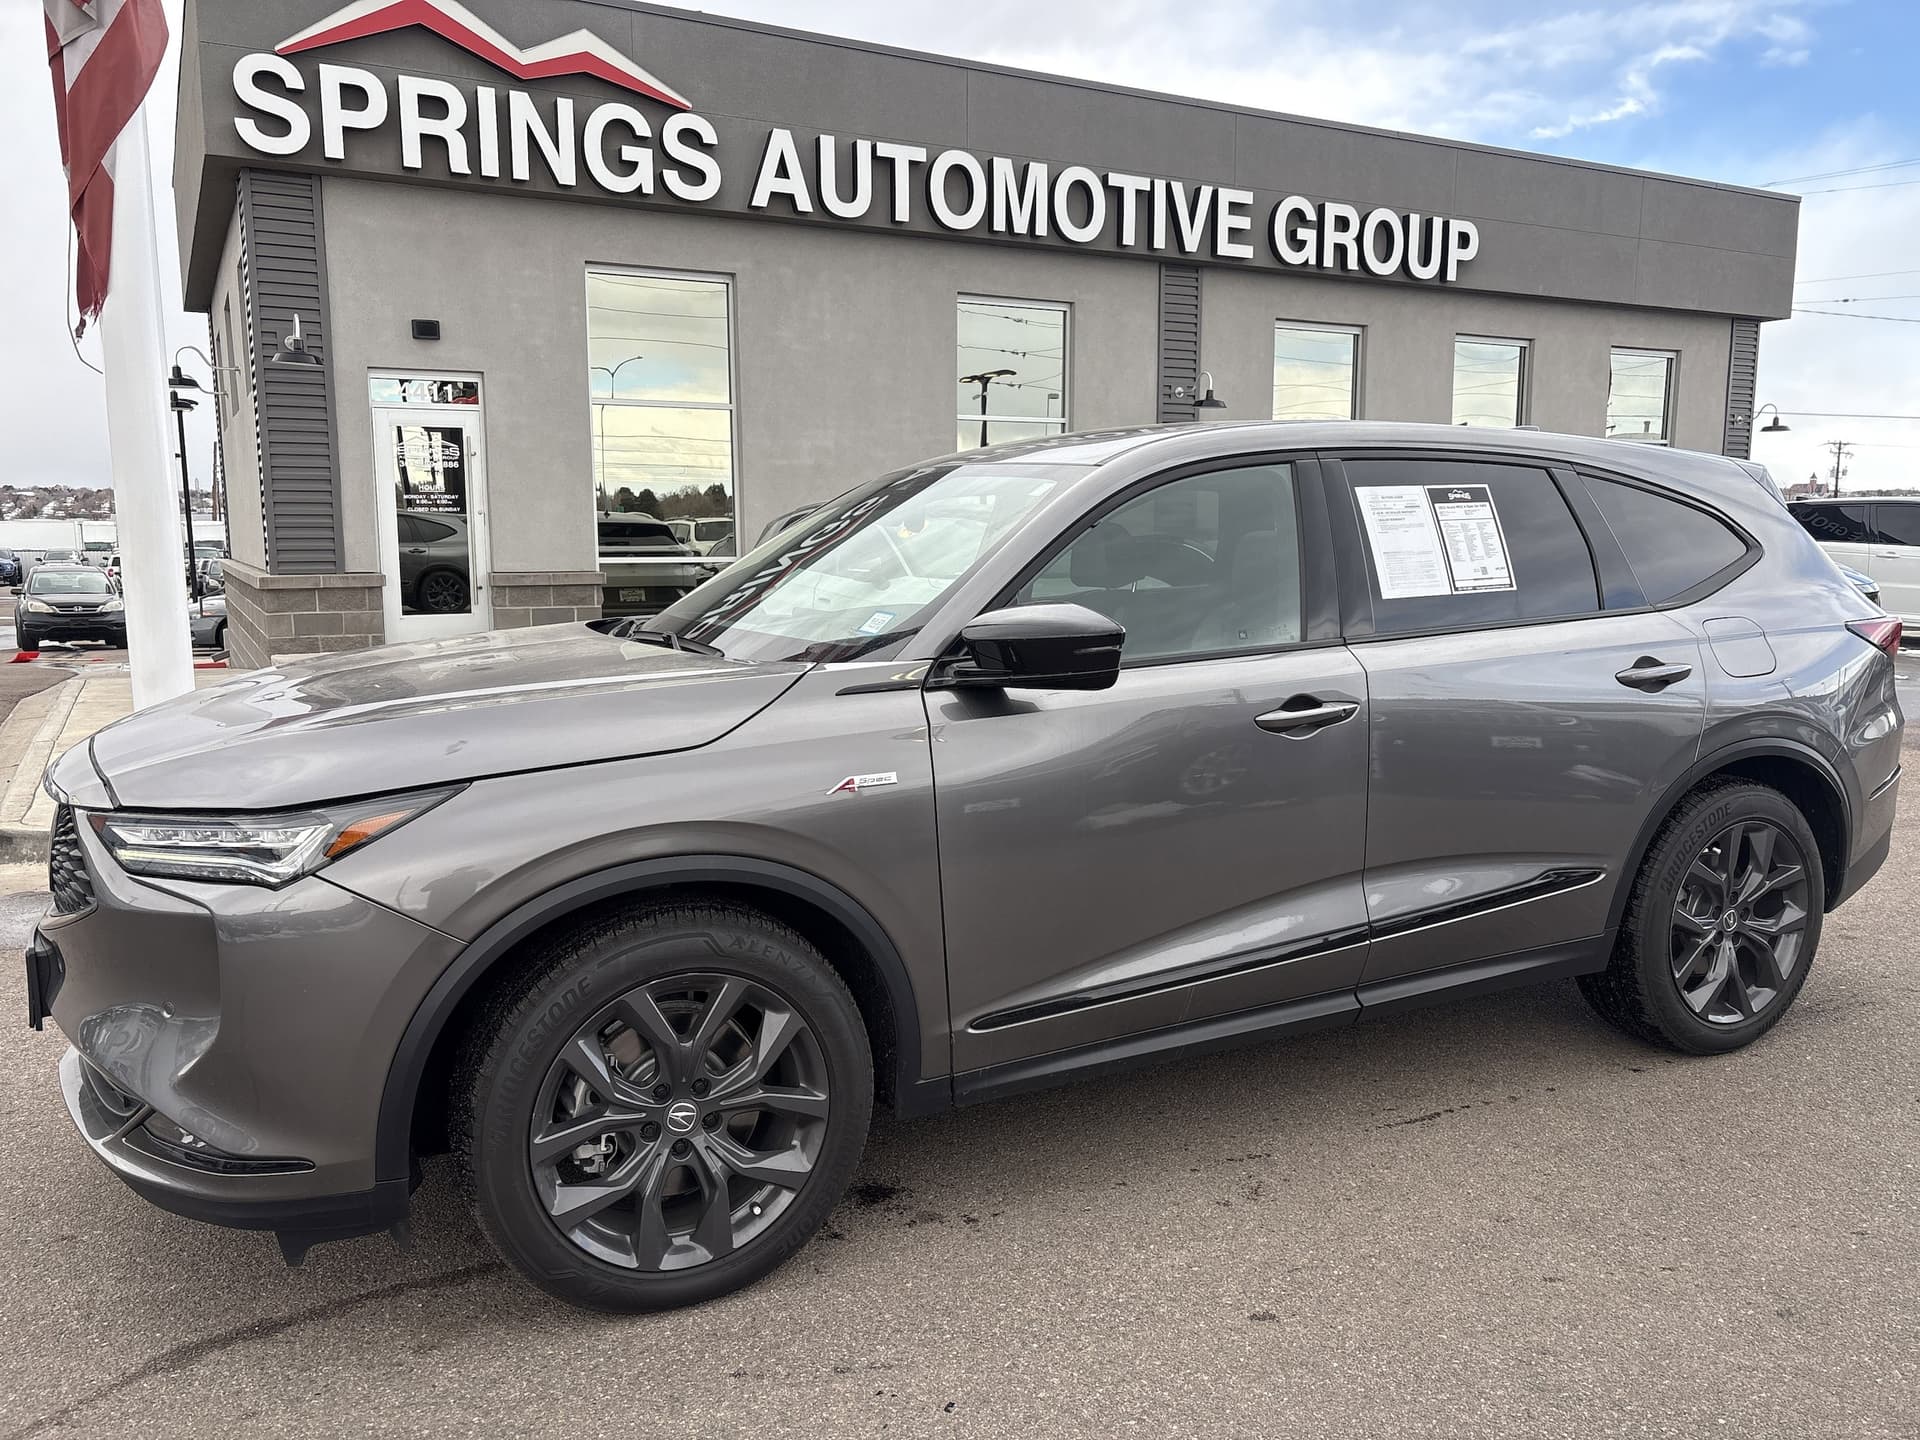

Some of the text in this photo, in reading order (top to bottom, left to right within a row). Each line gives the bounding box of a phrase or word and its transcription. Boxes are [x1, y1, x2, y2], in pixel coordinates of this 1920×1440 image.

[232, 52, 1480, 282] SPRINGS AUTOMOTIVE GROUP
[400, 382, 454, 403] 4411
[418, 484, 446, 492] HOURS
[1660, 802, 1733, 896] BRIDGESTONE
[488, 974, 593, 1152] BRIDGESTONE
